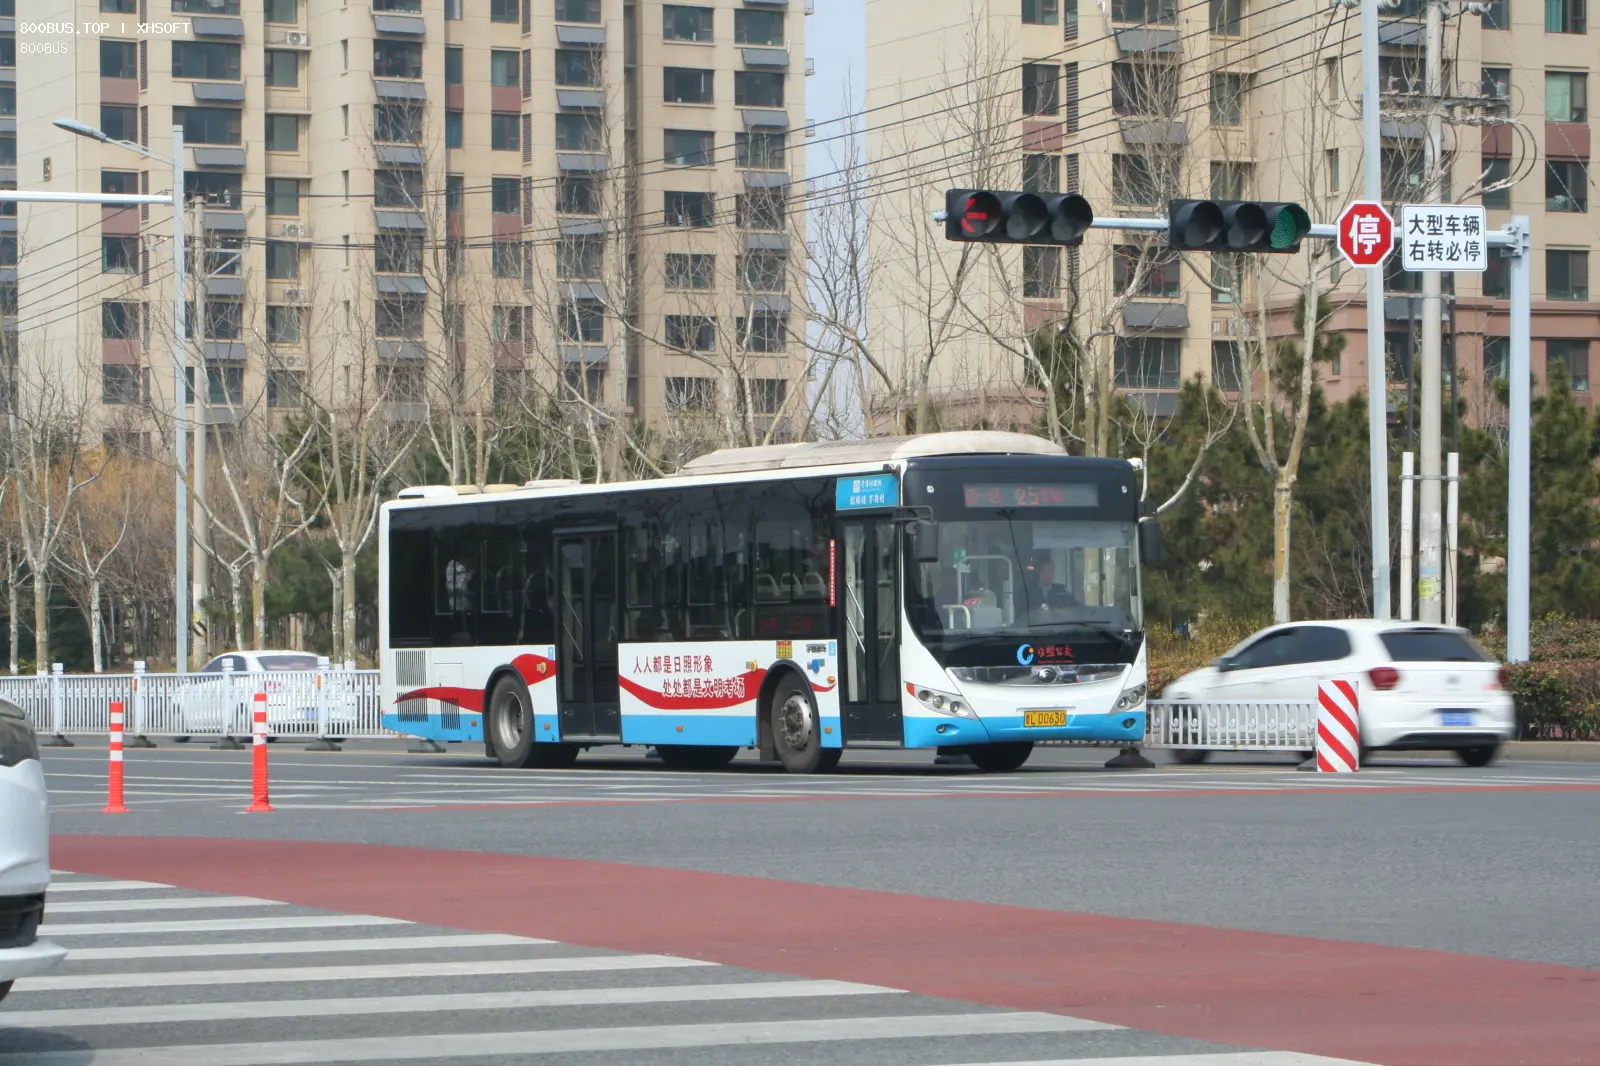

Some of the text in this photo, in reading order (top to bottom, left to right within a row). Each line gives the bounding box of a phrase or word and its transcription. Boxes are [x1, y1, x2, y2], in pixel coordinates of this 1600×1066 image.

[1349, 214, 1381, 255] 停
[1408, 214, 1480, 236] 大型车辆
[1409, 240, 1481, 262] 右转必停
[633, 655, 713, 674] 人人都是日照形象
[662, 677, 745, 699] 处处都是文明考场
